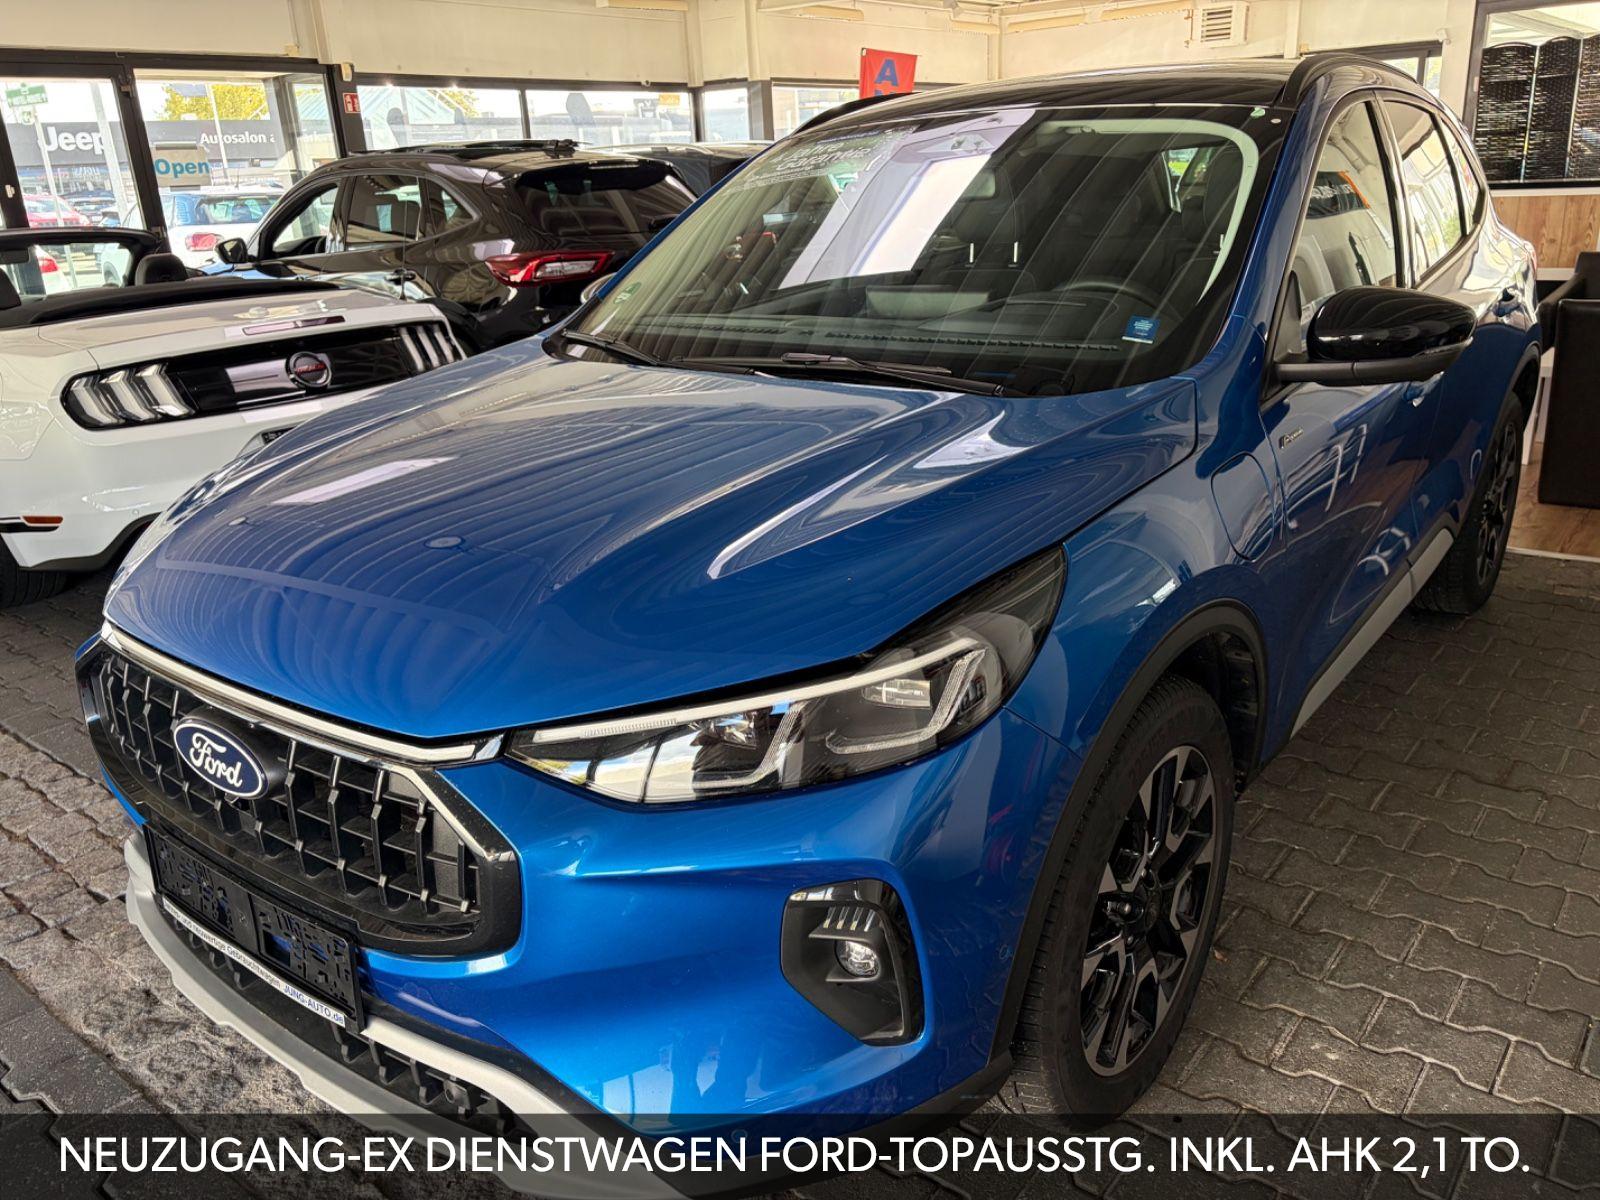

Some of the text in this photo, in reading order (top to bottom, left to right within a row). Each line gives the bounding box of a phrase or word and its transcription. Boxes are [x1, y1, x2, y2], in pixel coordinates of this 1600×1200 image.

[38, 126, 105, 156] Jeep
[155, 158, 210, 179] Open
[188, 733, 243, 787] Ford
[282, 984, 345, 1025] JUNG-AUTO.de
